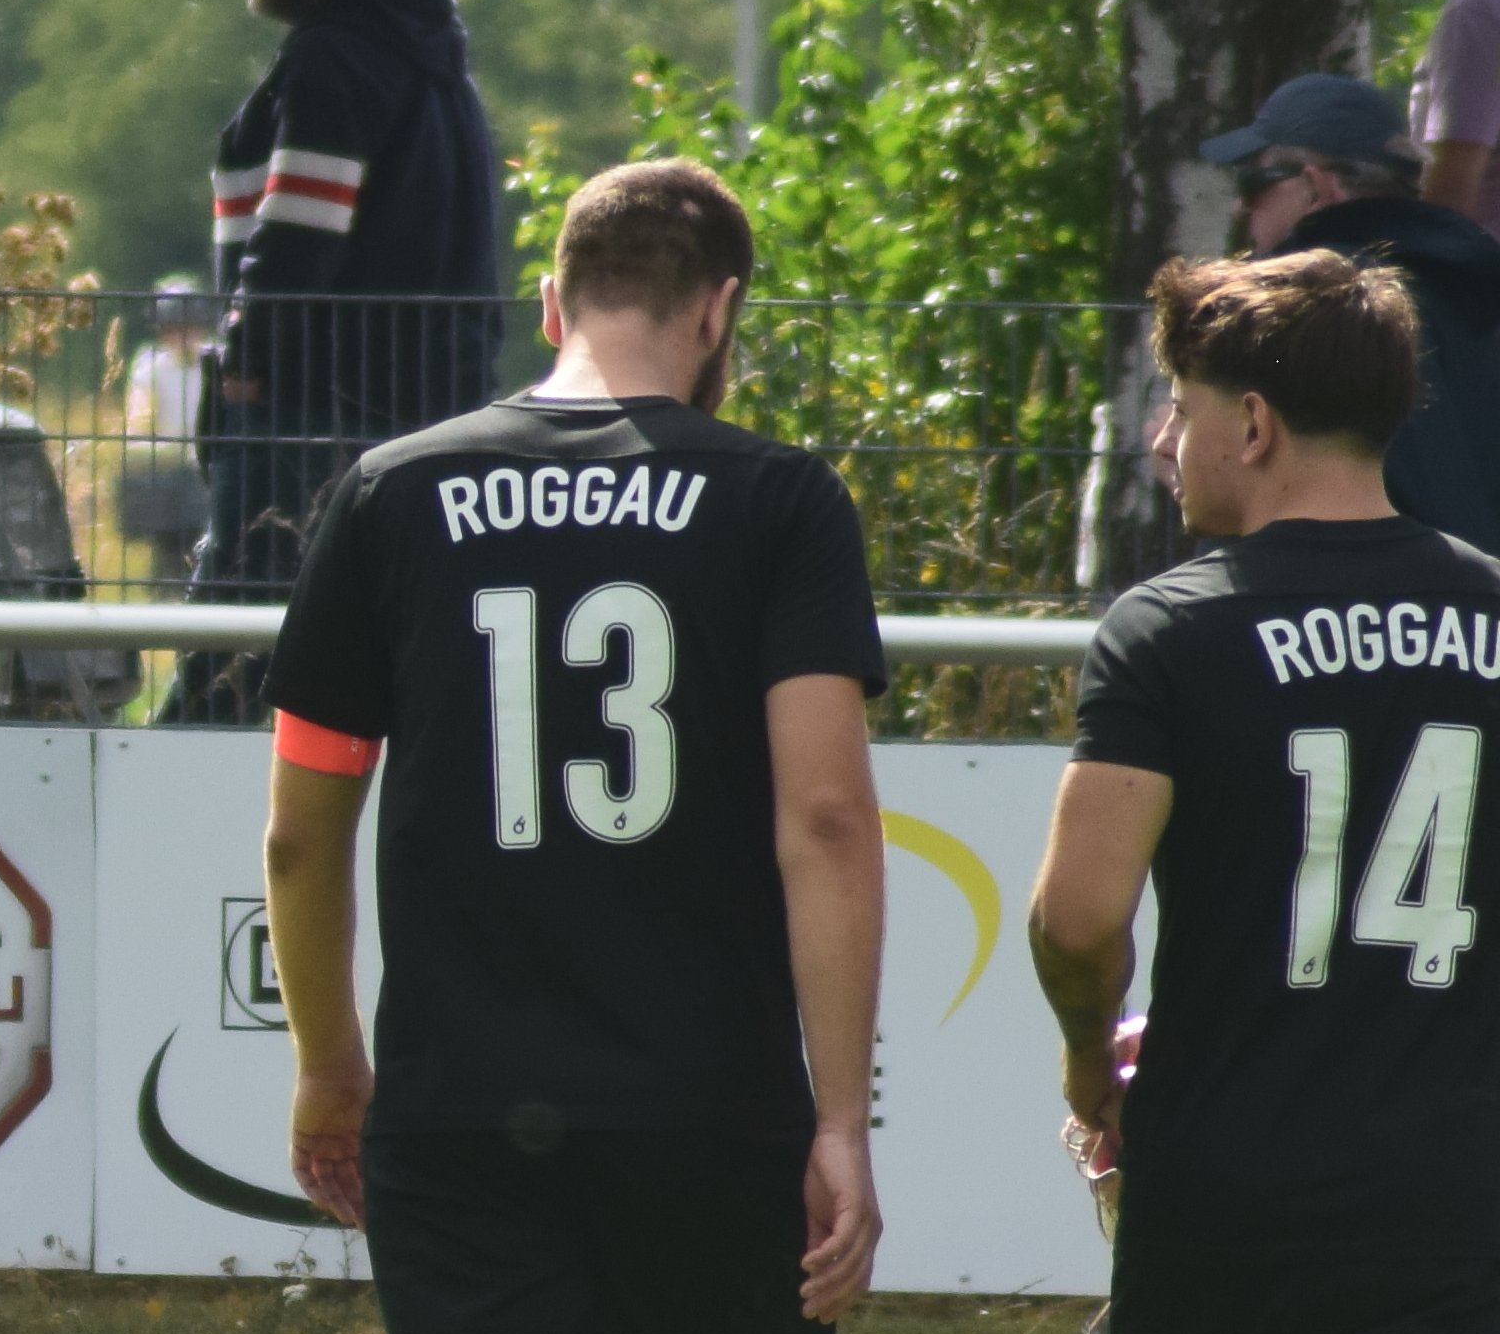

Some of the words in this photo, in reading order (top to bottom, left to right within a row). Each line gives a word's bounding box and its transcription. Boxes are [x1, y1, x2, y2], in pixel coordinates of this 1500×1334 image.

[437, 465, 706, 543] ROGGAU
[473, 581, 677, 850] 13
[1256, 601, 1500, 685] ROGGAU
[1287, 722, 1483, 989] 14
